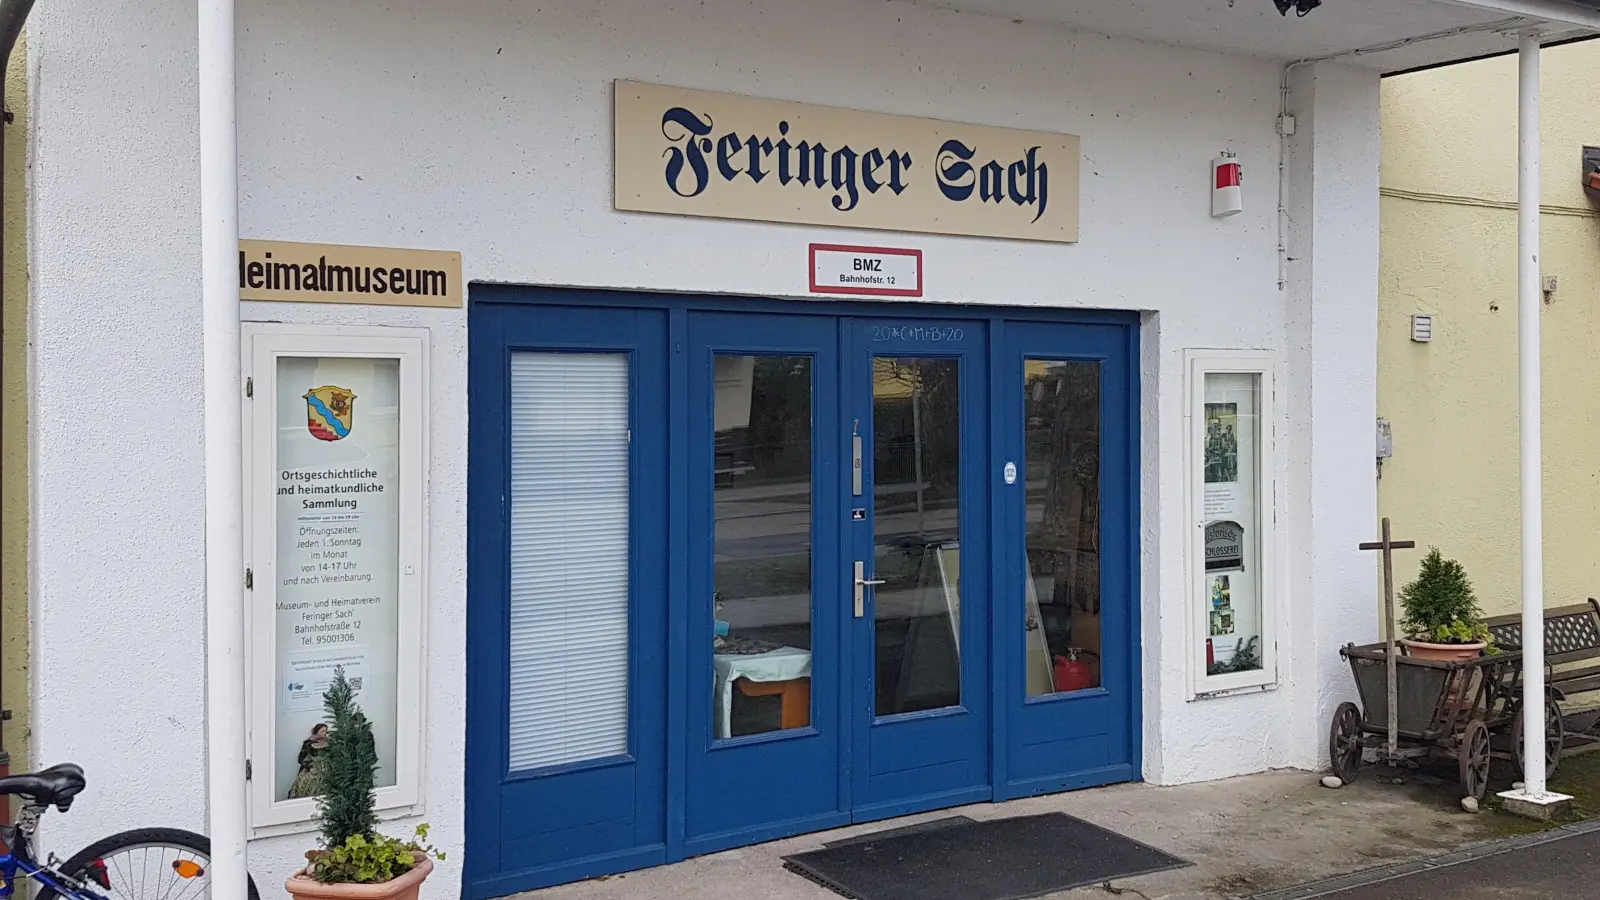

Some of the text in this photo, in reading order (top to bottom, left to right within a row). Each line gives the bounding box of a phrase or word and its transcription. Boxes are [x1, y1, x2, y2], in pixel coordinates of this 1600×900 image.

[661, 107, 1048, 224] Feringer Sach
[853, 258, 882, 272] BMZ
[839, 274, 896, 284] Bahnhofstr. 12
[281, 469, 378, 482] Ortsgeschichtliche
[298, 483, 384, 494] heimatkundliche
[302, 498, 358, 509] Sammlung
[299, 526, 360, 537] Öffnungszeiten:
[297, 540, 319, 548] Jeden
[330, 538, 362, 547] Sonntag
[310, 551, 348, 560] im Monat
[318, 562, 341, 571] 14-17
[343, 562, 357, 570] Uhr
[283, 573, 373, 586] und nach Vereinbarung.
[275, 596, 381, 611] Museum- und Heimatverein
[302, 612, 333, 622] Feringer
[294, 620, 361, 634] Bahnhofstraße 12
[301, 633, 355, 645] Tel. 95001306
